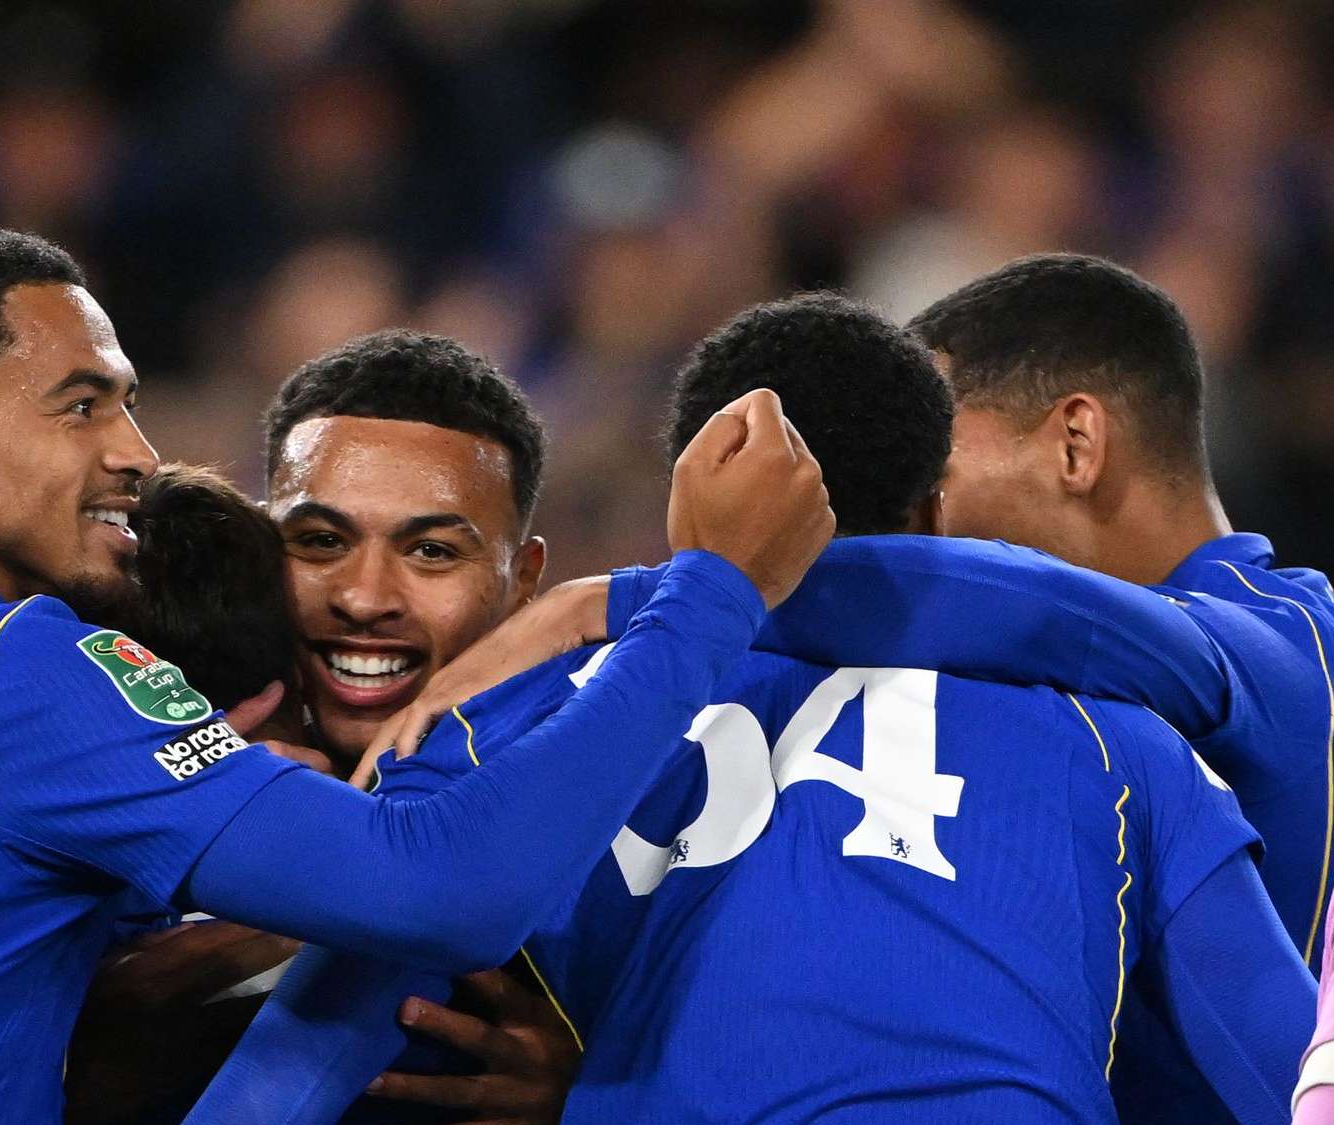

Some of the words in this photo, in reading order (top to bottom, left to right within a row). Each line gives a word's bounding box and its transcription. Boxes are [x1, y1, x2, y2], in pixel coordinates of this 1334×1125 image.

[123, 661, 175, 687] Carab
[147, 673, 174, 689] Cup
[154, 742, 193, 770] No
